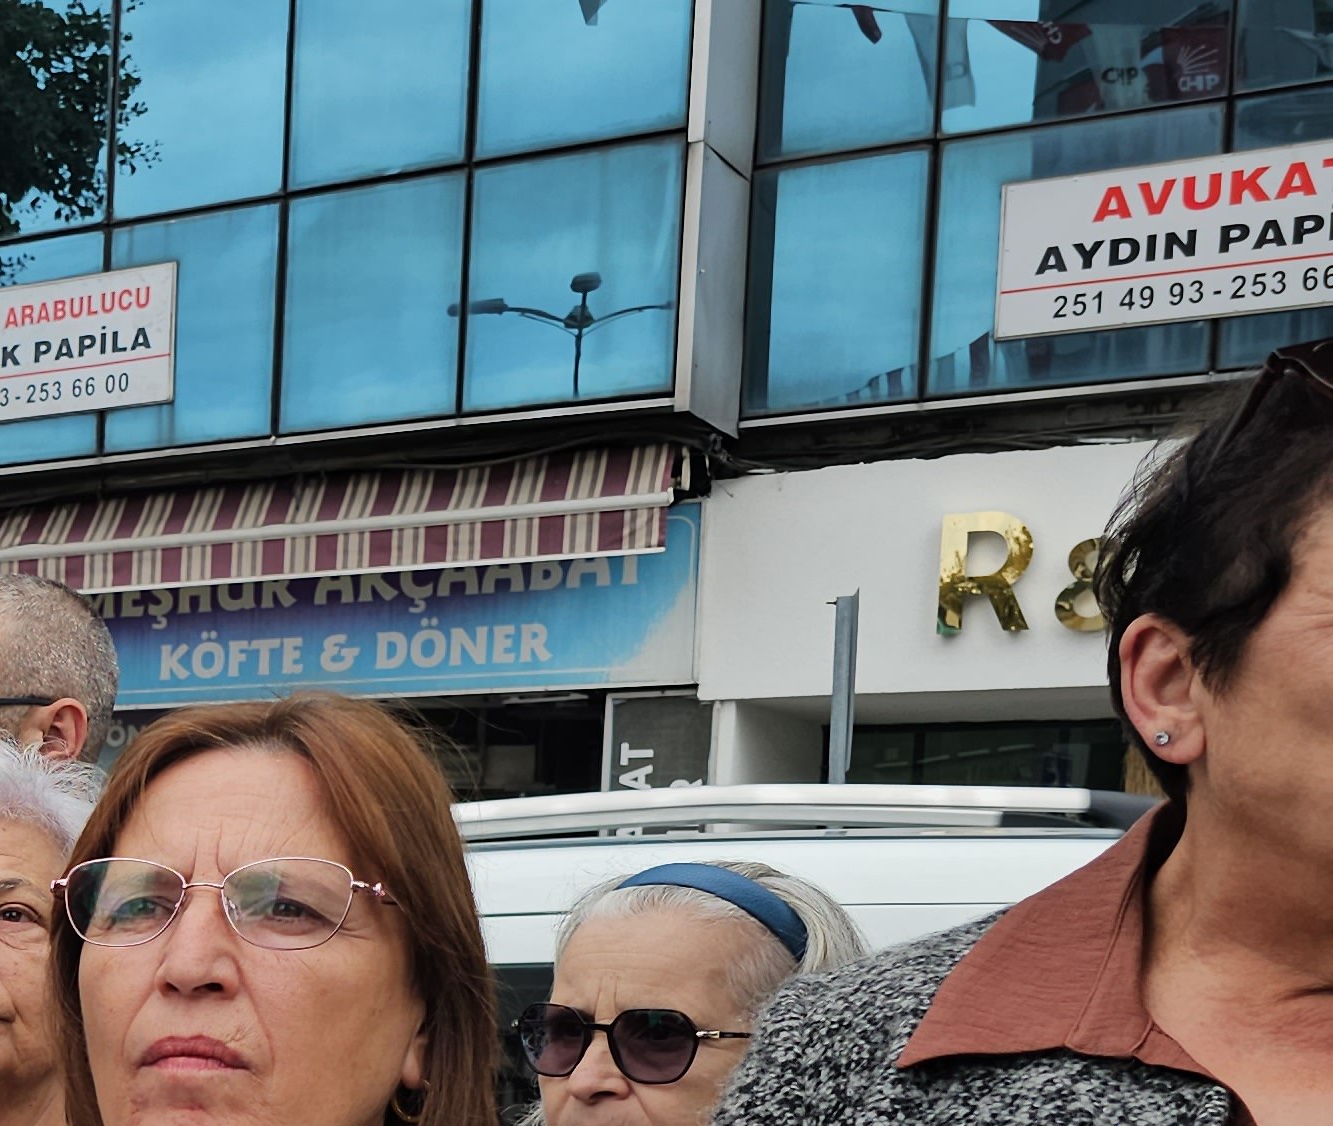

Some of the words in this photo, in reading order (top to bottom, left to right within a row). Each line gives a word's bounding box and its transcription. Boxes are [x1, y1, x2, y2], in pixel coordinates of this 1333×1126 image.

[1178, 73, 1220, 92] CHP
[1092, 158, 1333, 223] AVUKA
[1035, 229, 1198, 276] AYDIN
[1218, 210, 1333, 254] PAP
[4, 286, 151, 330] ARABULUCU
[1053, 291, 1102, 319] 251
[1120, 286, 1154, 310] 49
[34, 326, 152, 364] PAPİLA
[72, 377, 95, 398] 66
[106, 372, 129, 394] 00
[159, 630, 304, 681] KÖFTE
[319, 634, 360, 673] &
[374, 617, 553, 670] DÖNER
